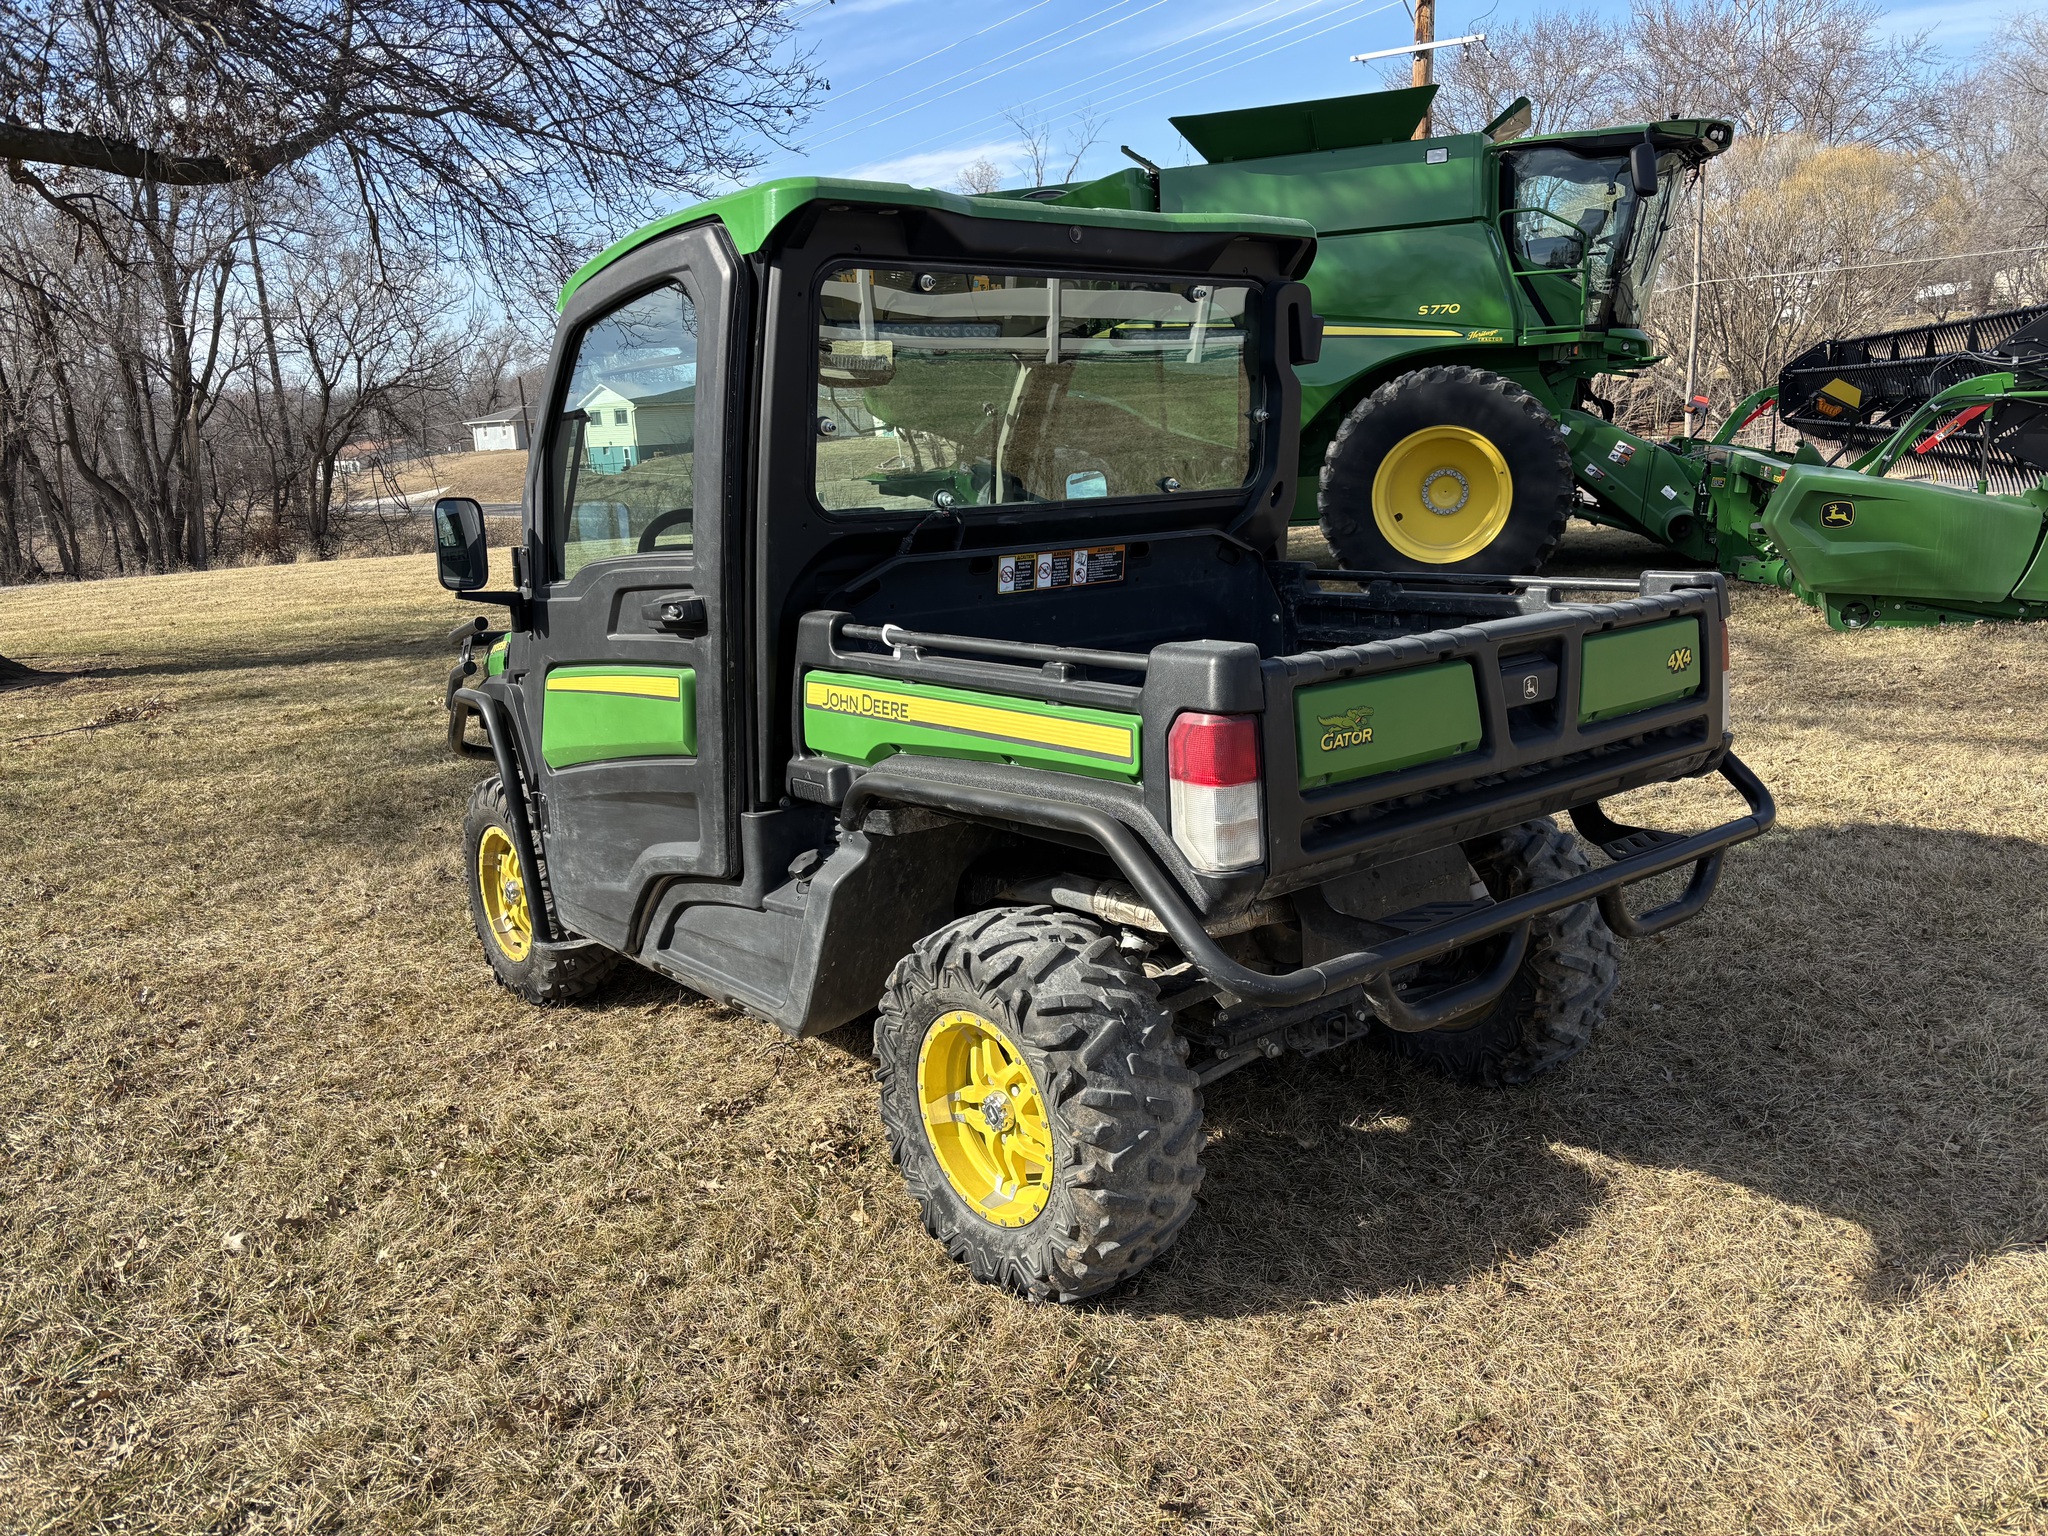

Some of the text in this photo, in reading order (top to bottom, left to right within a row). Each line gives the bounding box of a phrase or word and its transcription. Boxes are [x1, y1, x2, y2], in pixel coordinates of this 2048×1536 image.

[1466, 329, 1499, 341] Heritage
[1667, 648, 1692, 671] 4X4
[822, 688, 909, 719] JOHN DEERE
[1320, 727, 1373, 751] GATOR
